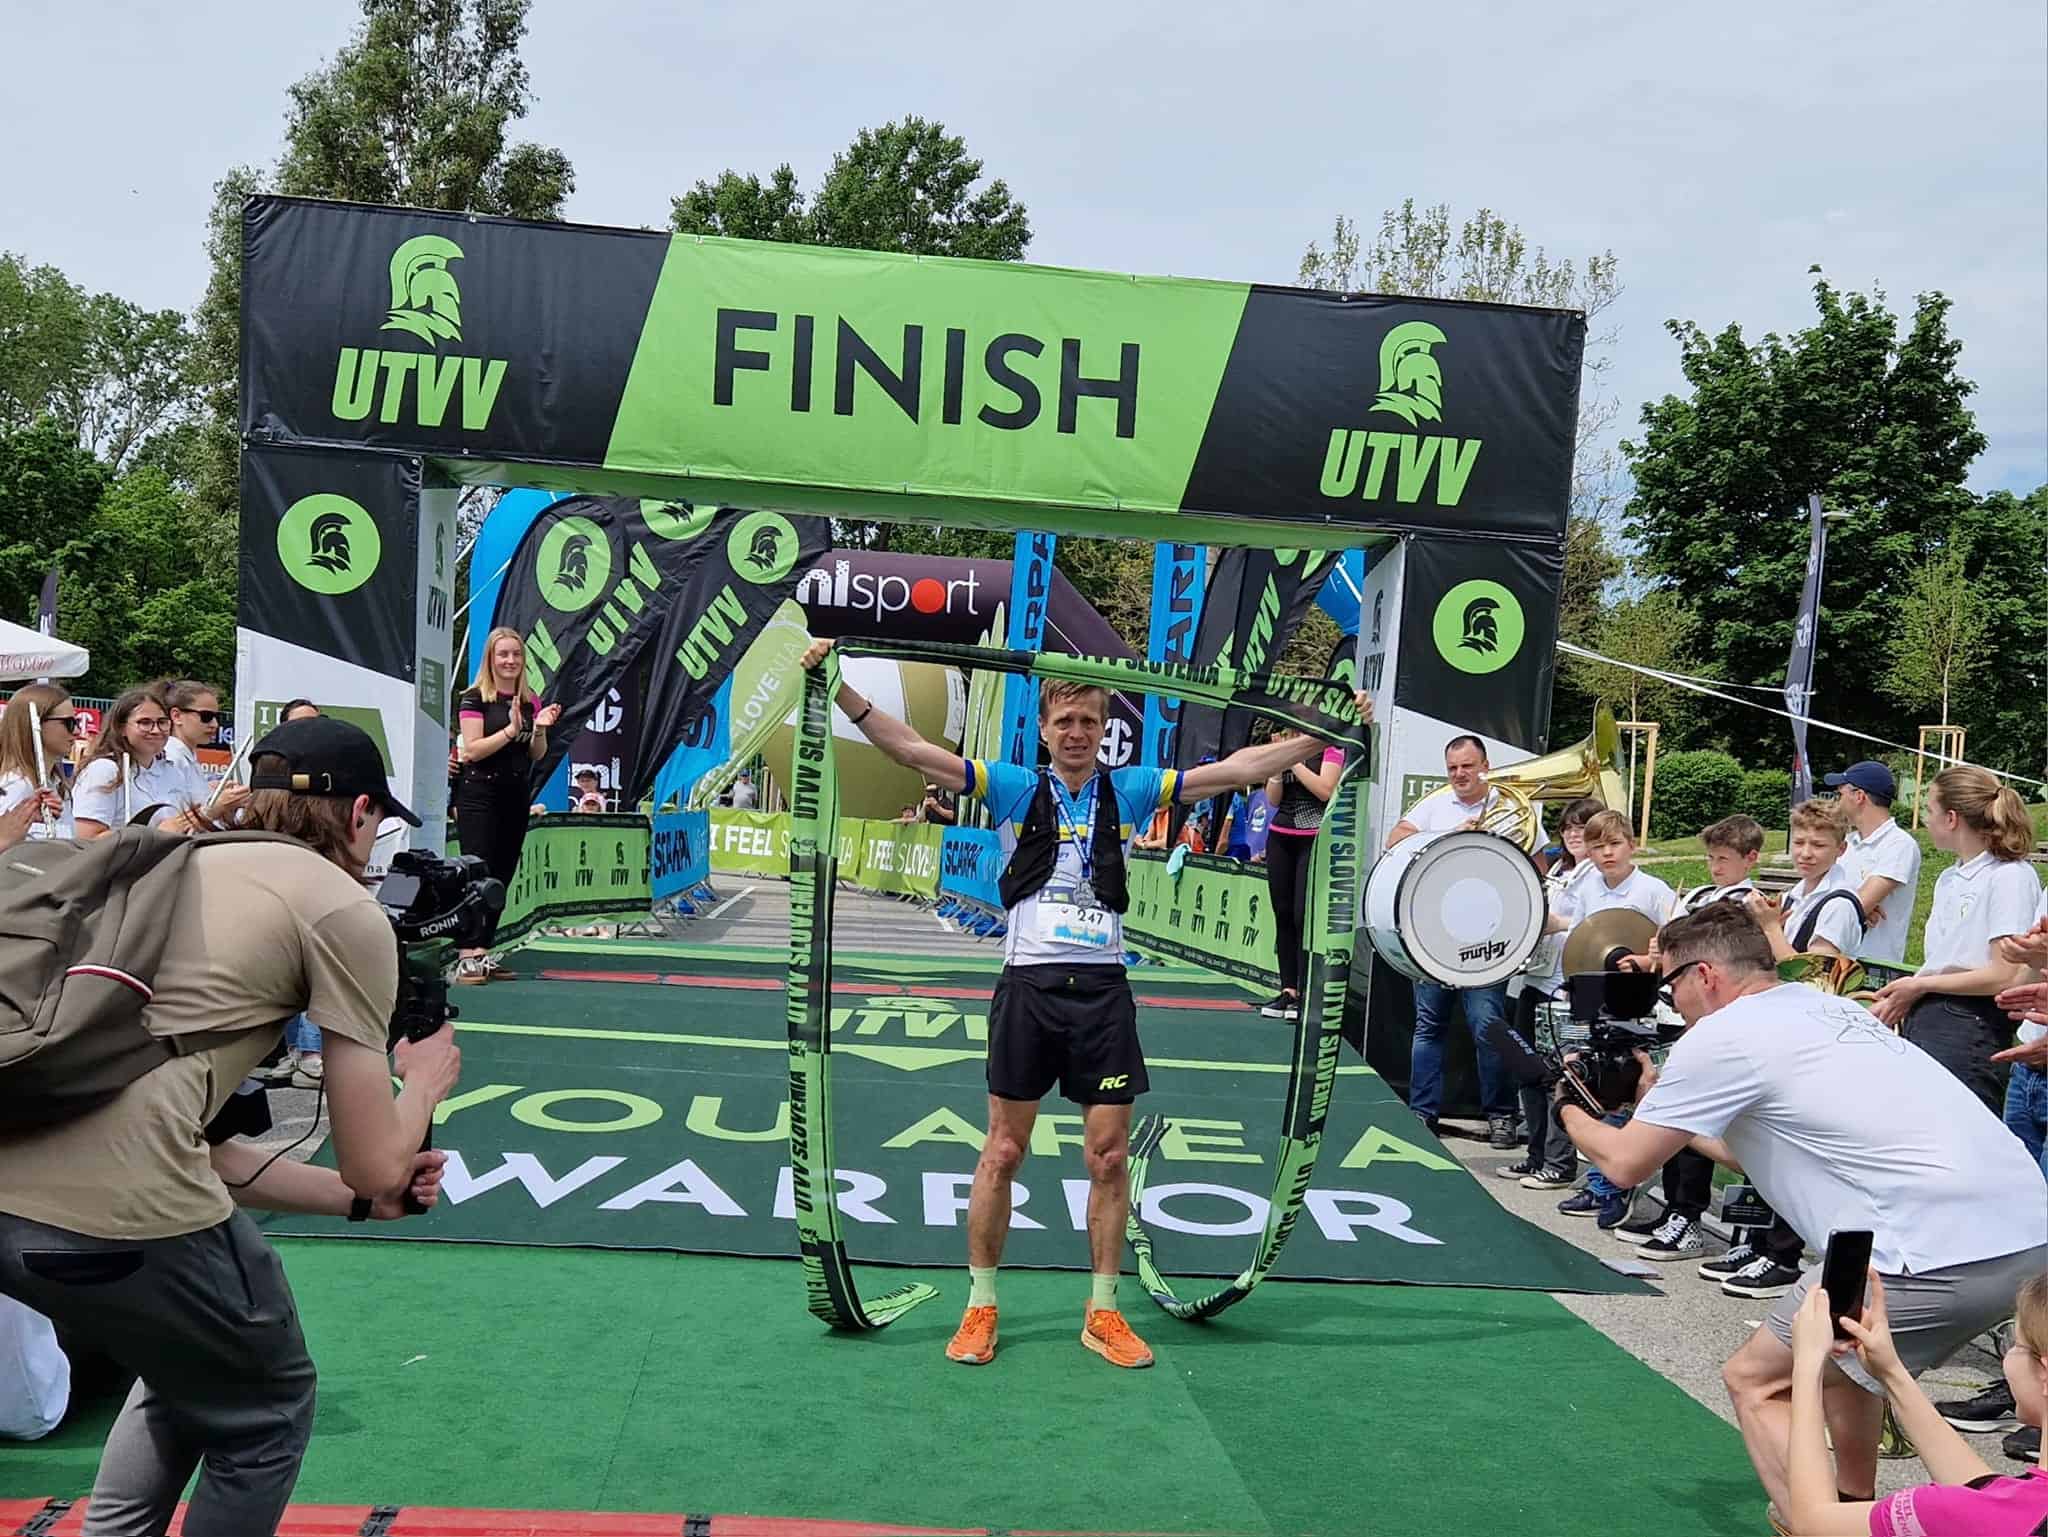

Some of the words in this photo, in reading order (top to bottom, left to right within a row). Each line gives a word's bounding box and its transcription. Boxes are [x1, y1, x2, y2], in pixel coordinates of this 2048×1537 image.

[331, 347, 508, 430] UTVV
[712, 308, 1140, 439] FINISH
[1319, 428, 1481, 506] UTVV
[676, 584, 749, 681] UTVV
[1265, 672, 1323, 707] UTVV
[793, 764, 821, 821] UTVV
[724, 825, 774, 857] FEEL
[1327, 842, 1356, 935] SLOVENIA
[419, 913, 460, 938] RONIN
[788, 870, 816, 968] SLOVENIA
[1077, 909, 1104, 926] 247
[786, 973, 809, 1025] UTVV
[1321, 980, 1347, 1030] UTVV
[1099, 1074, 1129, 1091] RC
[1309, 1034, 1339, 1122] SLOVENIA
[790, 1071, 809, 1160] SLOVENIA
[1339, 1125, 1465, 1171] A
[441, 1149, 1446, 1245] WARRIOR
[792, 1160, 814, 1214] UTVV
[1286, 1161, 1314, 1207] UTVV
